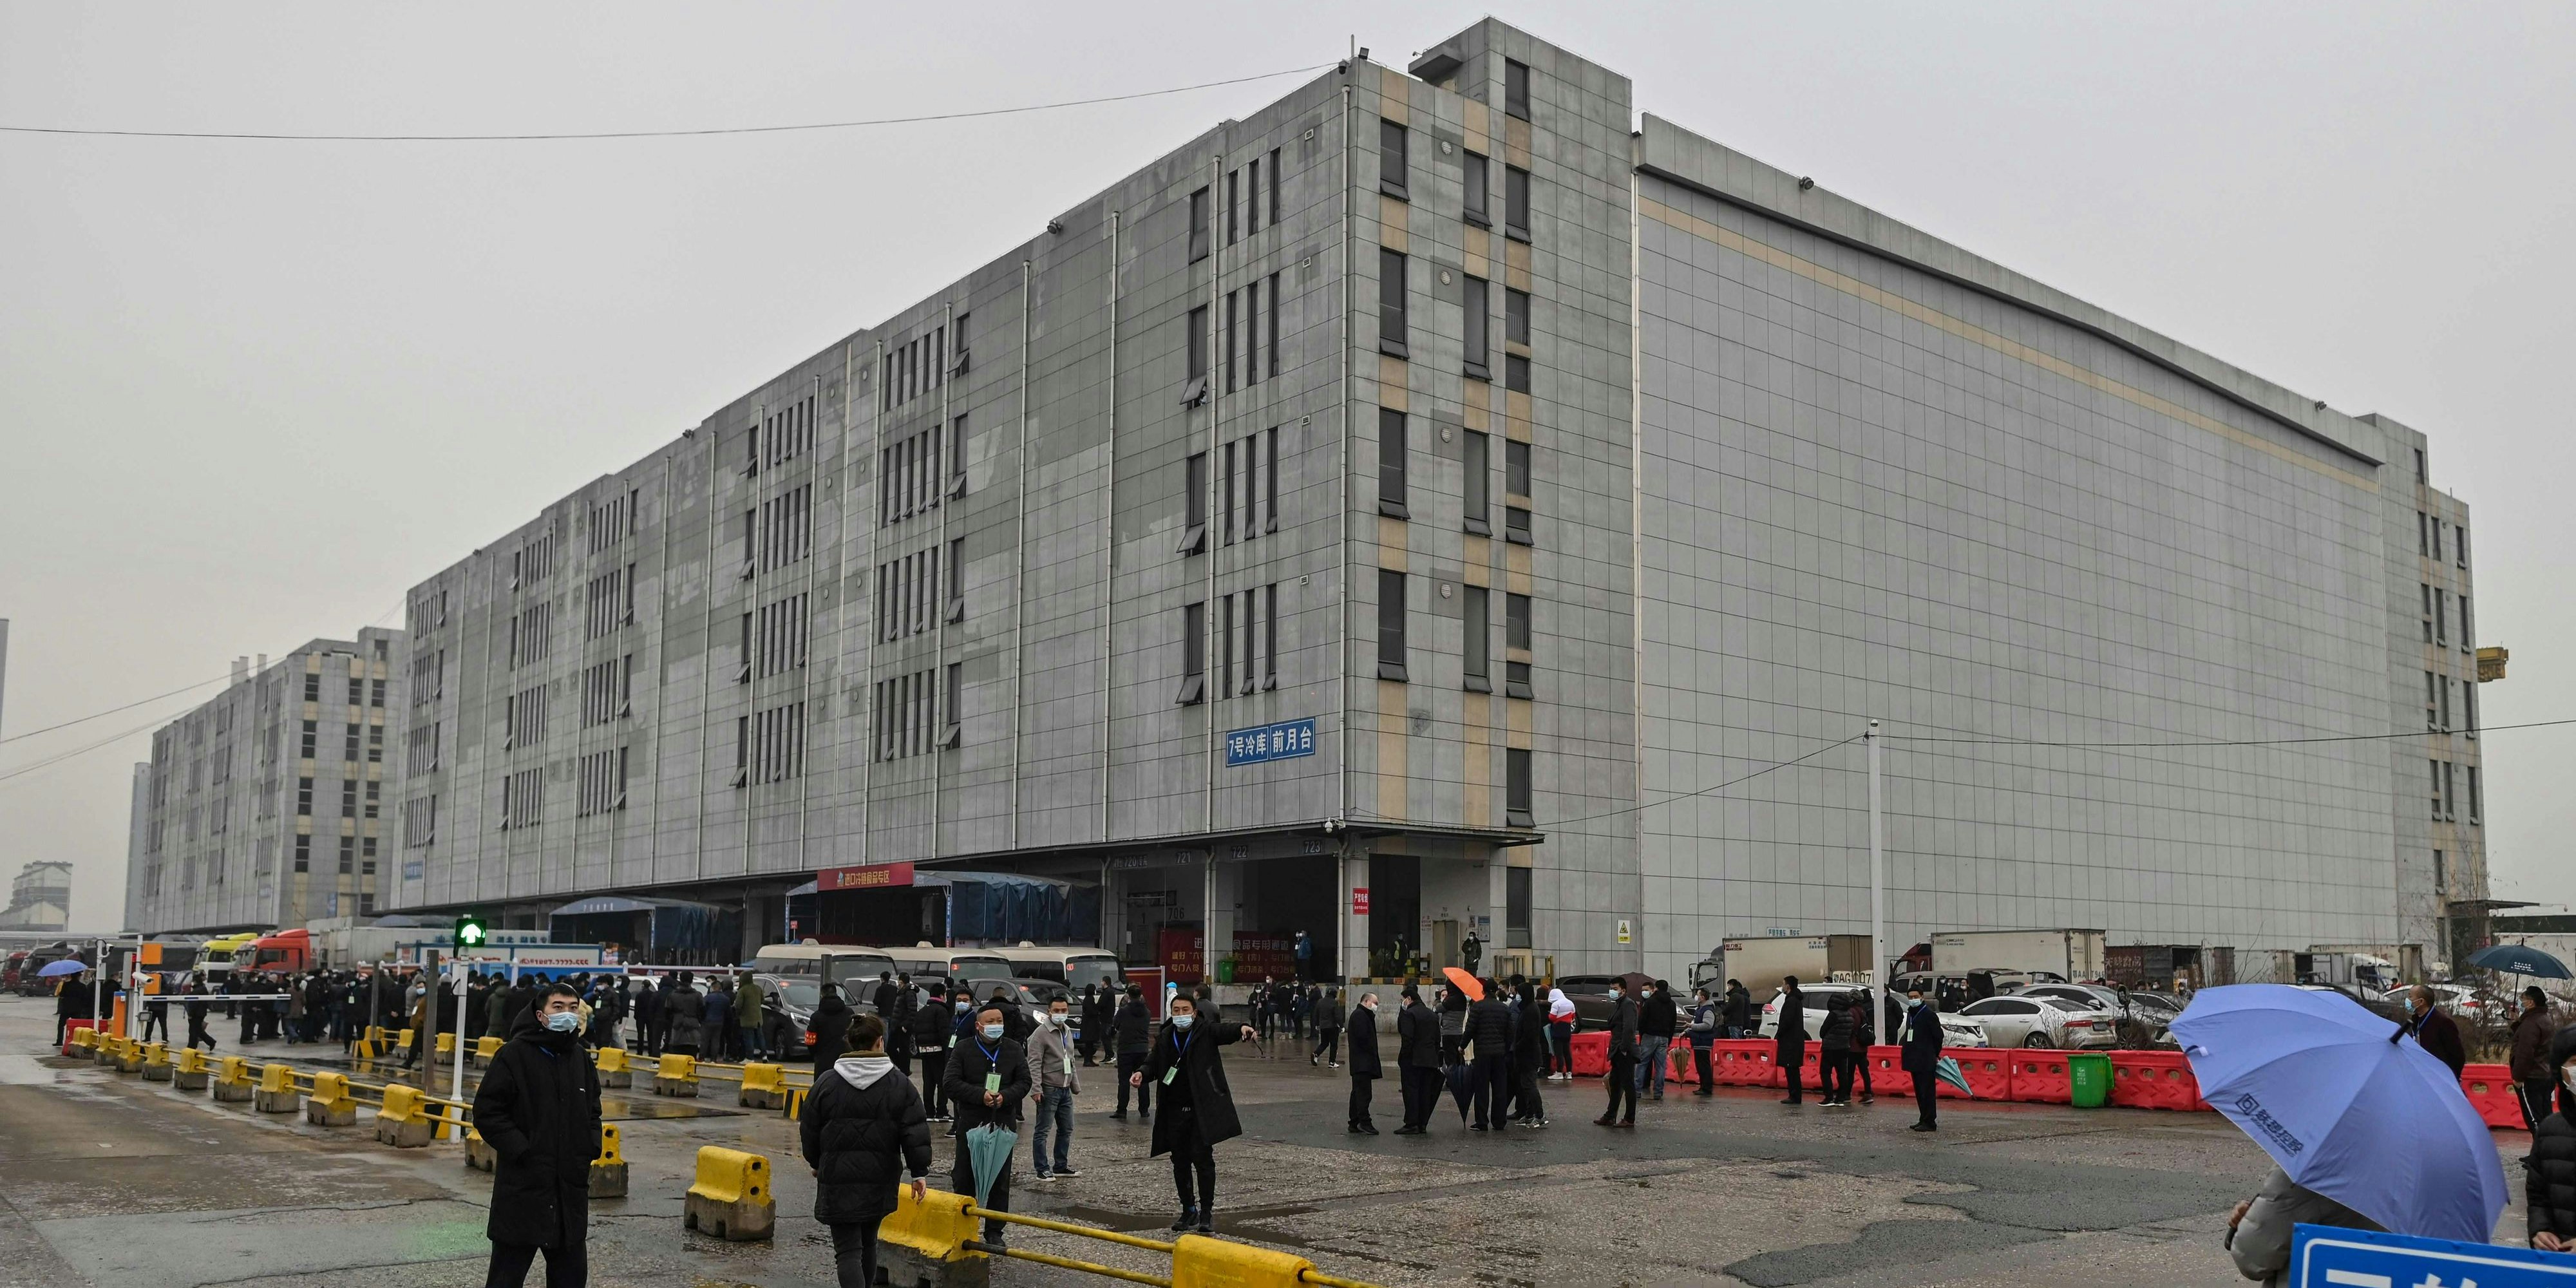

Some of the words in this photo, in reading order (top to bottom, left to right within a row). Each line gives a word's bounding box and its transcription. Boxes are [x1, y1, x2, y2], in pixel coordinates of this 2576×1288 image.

[1229, 732, 1266, 757] 7号冷库
[1273, 726, 1312, 753] 前月台
[1233, 846, 1247, 858] 722
[1305, 840, 1320, 853] 723
[1177, 851, 1191, 864] 721
[1168, 907, 1184, 920] 706
